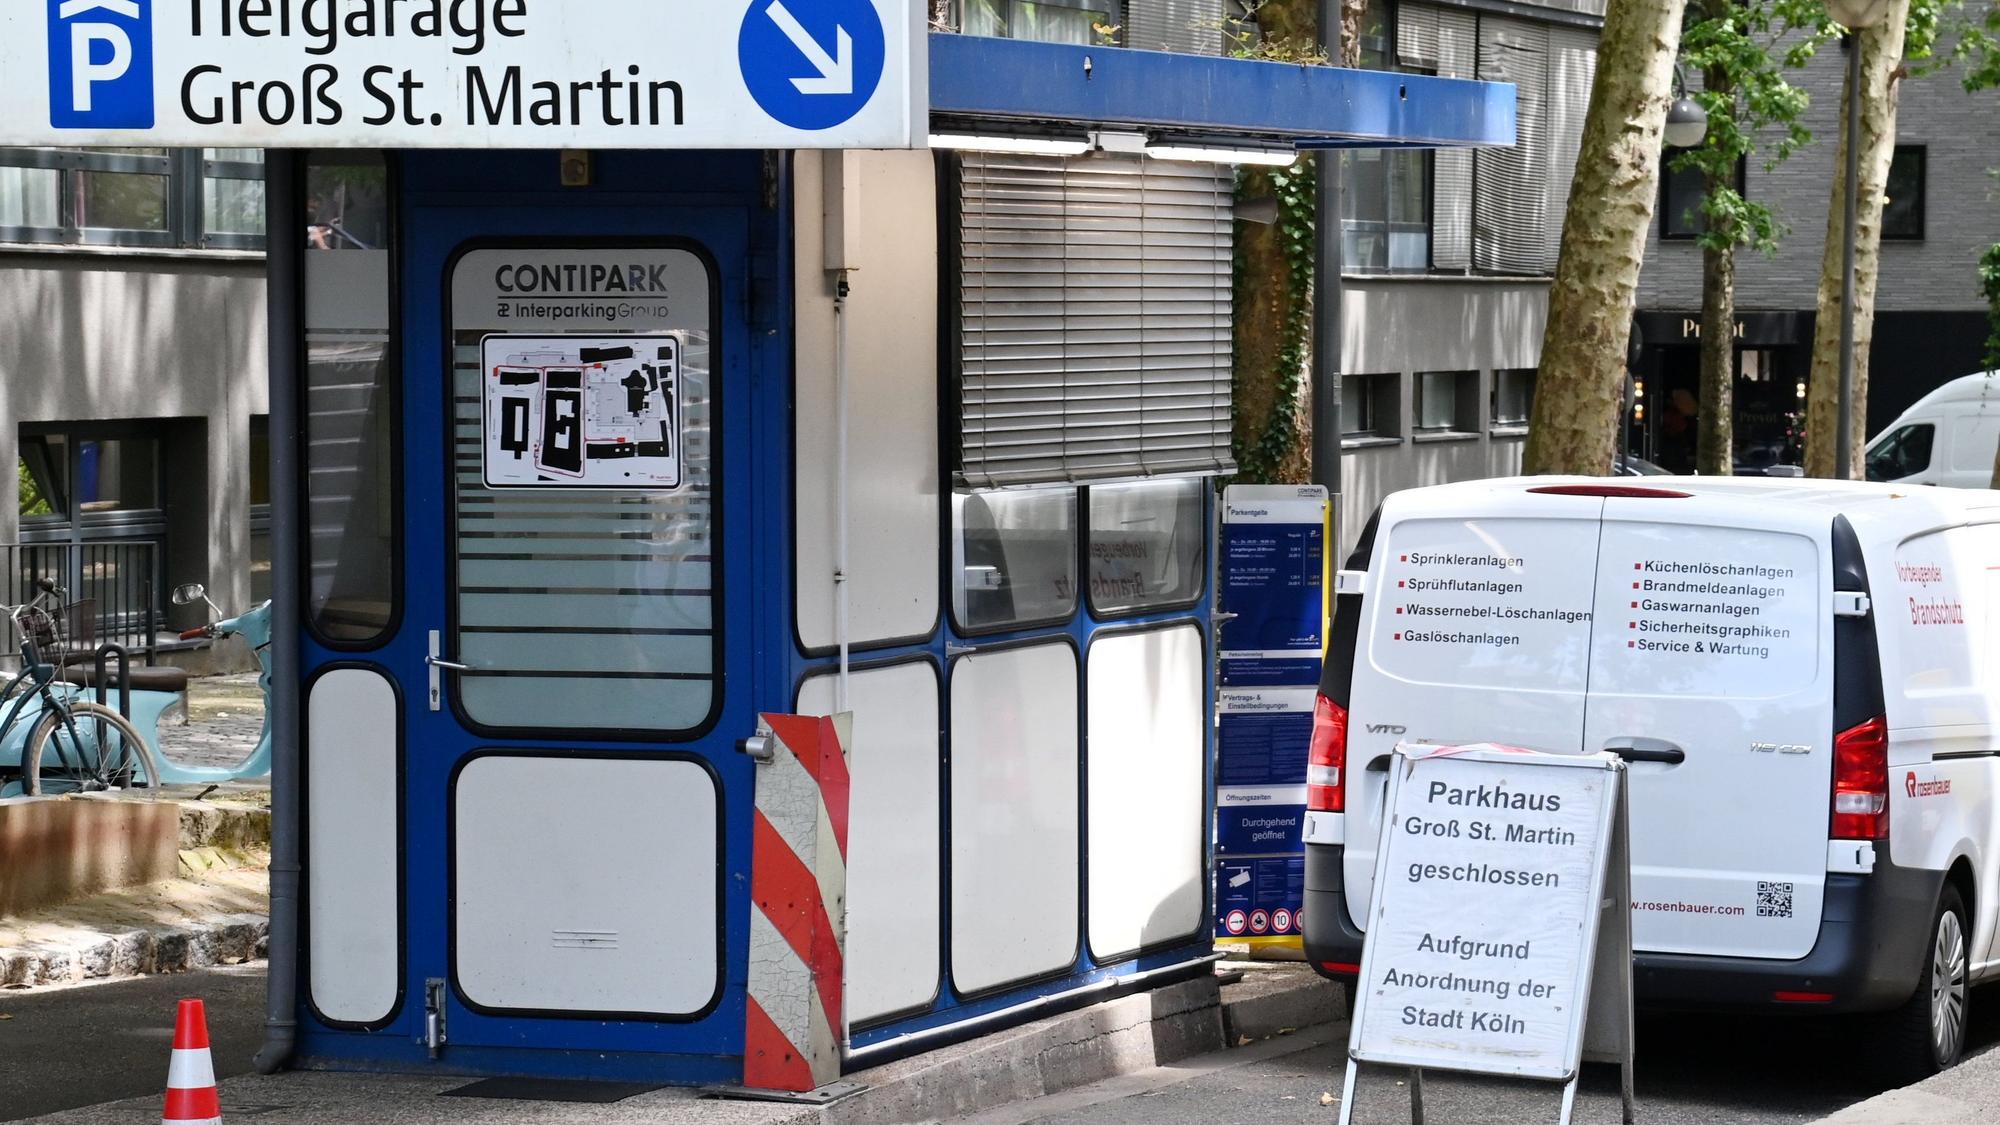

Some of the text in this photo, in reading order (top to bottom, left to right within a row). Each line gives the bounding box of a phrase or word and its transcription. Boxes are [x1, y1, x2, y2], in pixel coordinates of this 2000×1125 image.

[181, 64, 684, 126] Groß St. Martin
[495, 264, 668, 292] CONTIPARK
[1683, 318, 1745, 338] Prt
[1230, 509, 1268, 517] Parkentgelte
[1410, 552, 1524, 570] Sprinkleranlagen
[1644, 560, 1793, 580] Küchenlöschanlagen
[1894, 561, 1943, 588] Vorbeugender
[1408, 577, 1523, 595] Sprühflutanlagen
[1643, 578, 1785, 598] Brandmeldeanlagen
[1406, 603, 1591, 624] Wassernebel-Löschanlagen
[1641, 599, 1760, 618] Gaswarnanlagen
[1909, 597, 1964, 625] Brandschutz
[1404, 629, 1520, 648] Gaslöschanlagen
[1639, 619, 1790, 639] Sicherheitsgraphiken
[1637, 638, 1769, 659] Service & Wartung
[1228, 702, 1288, 711] Einstellbedingungen
[1366, 724, 1406, 735] VITO
[1917, 775, 1951, 797] rosenbauer
[1226, 793, 1272, 803] Öffnungszeiten
[1428, 781, 1561, 812] Parkhaus
[1242, 817, 1296, 829] Durchgehend
[1405, 816, 1575, 846] Groß St. Martin
[1252, 831, 1286, 842] geöffnet
[1408, 863, 1559, 888] geschlossen
[1277, 914, 1287, 926] 10
[1417, 933, 1530, 960] Aufgrund
[1383, 968, 1556, 999] Anordnung der
[1402, 1006, 1525, 1035] Stadt Köln
